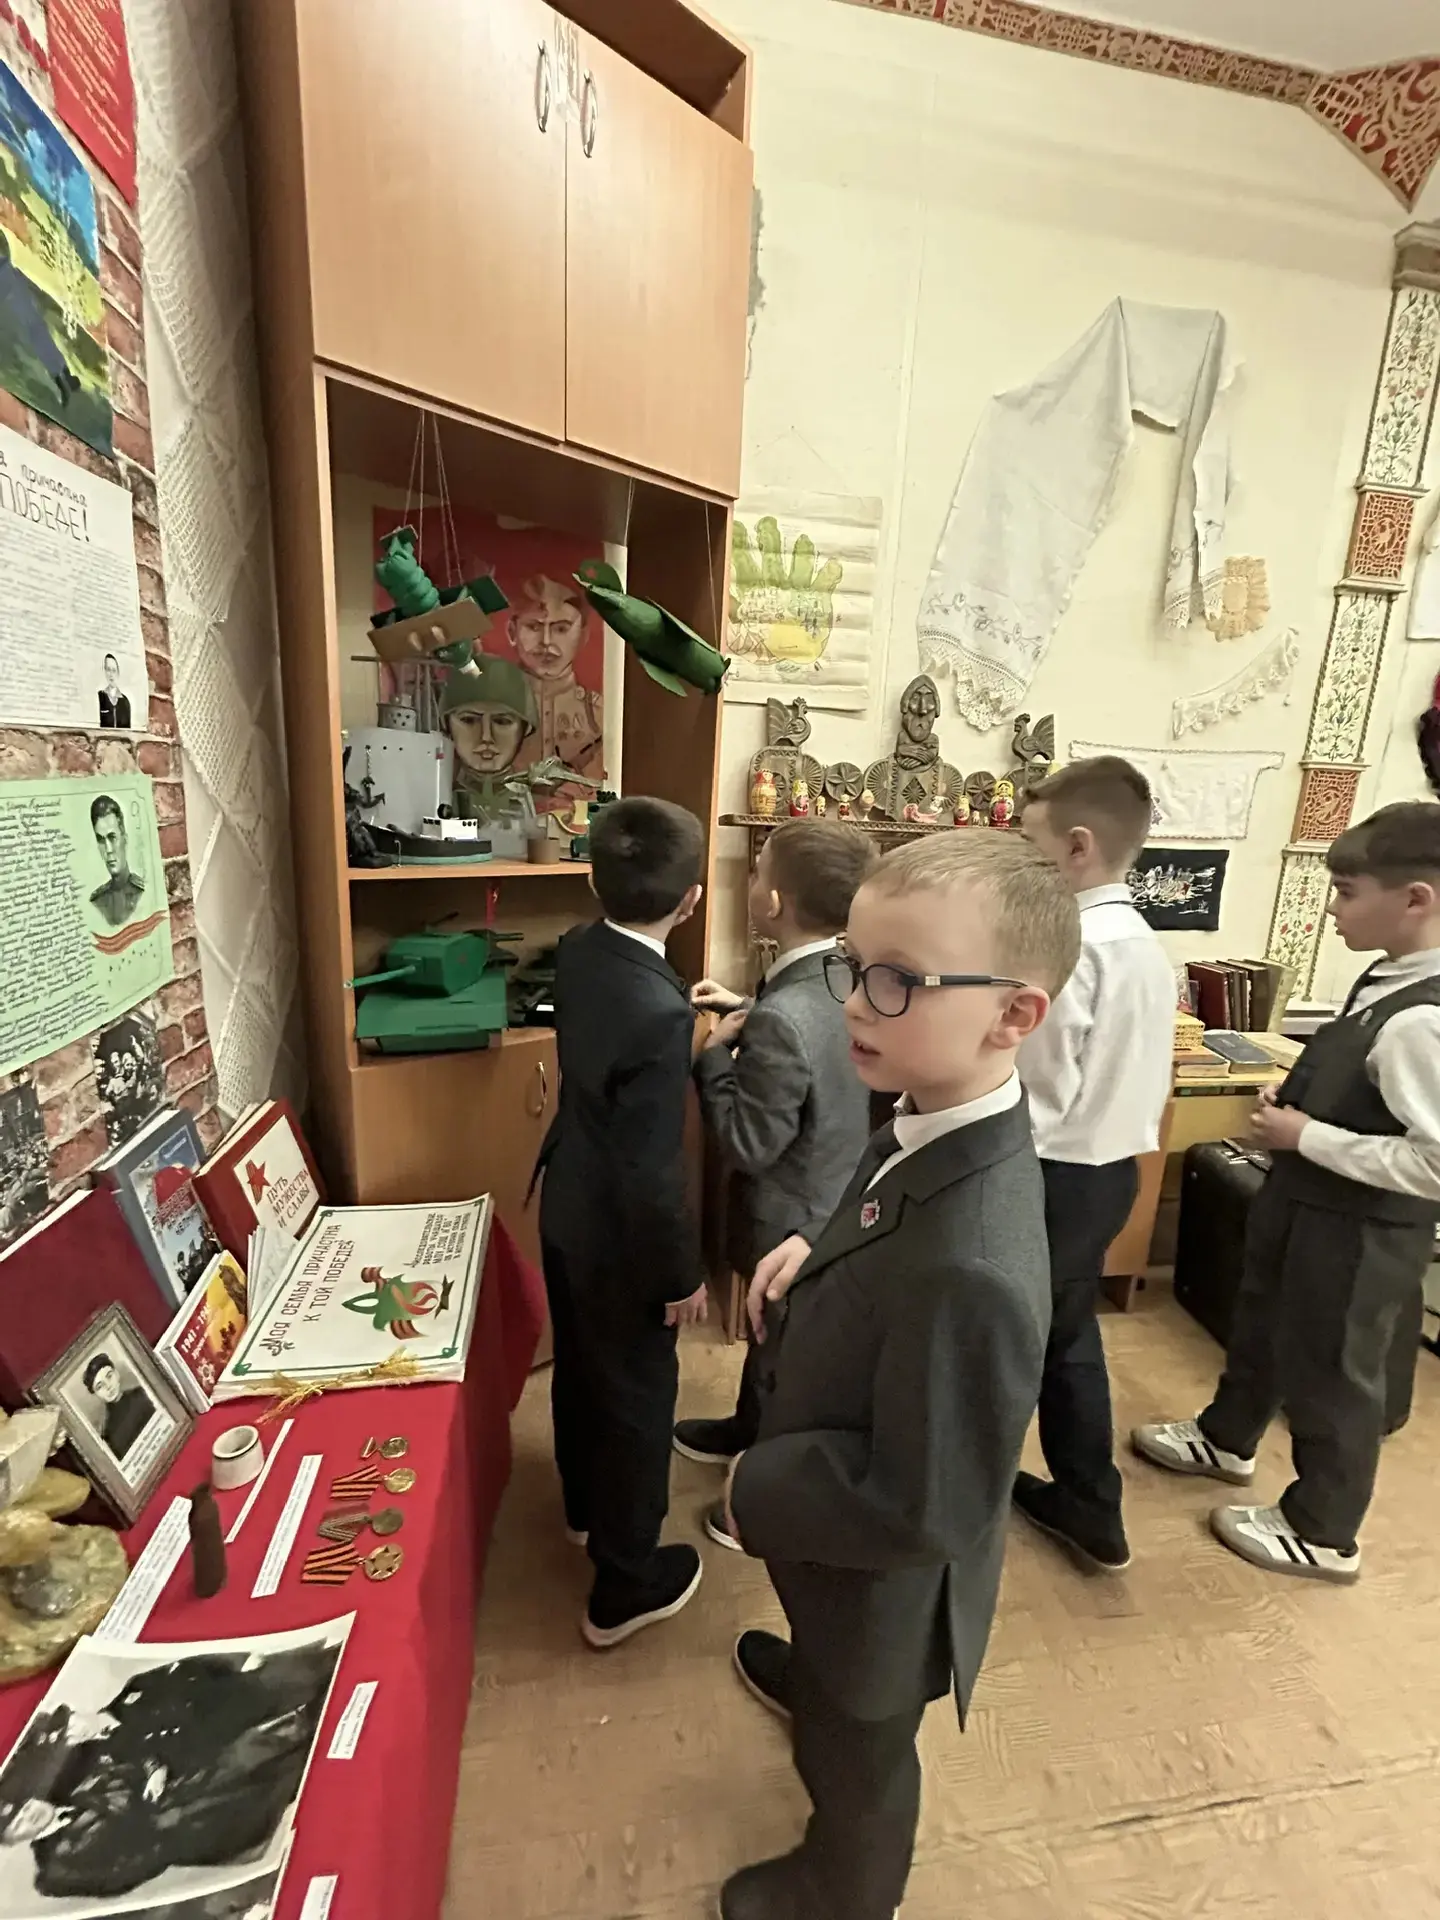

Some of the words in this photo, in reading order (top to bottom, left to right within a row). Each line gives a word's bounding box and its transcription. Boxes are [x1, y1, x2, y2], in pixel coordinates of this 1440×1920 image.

[266, 1176, 289, 1204] ПУТЬ
[272, 1168, 309, 1216] МУЖЕСТВА
[286, 1183, 311, 1218] СЛАВЫ
[281, 1280, 313, 1316] СЕМЬЯ
[302, 1224, 342, 1276] ПРИЧАСТНА
[309, 1285, 335, 1308] ТОЙ
[302, 1313, 321, 1322] К
[181, 1329, 197, 1353] 1941
